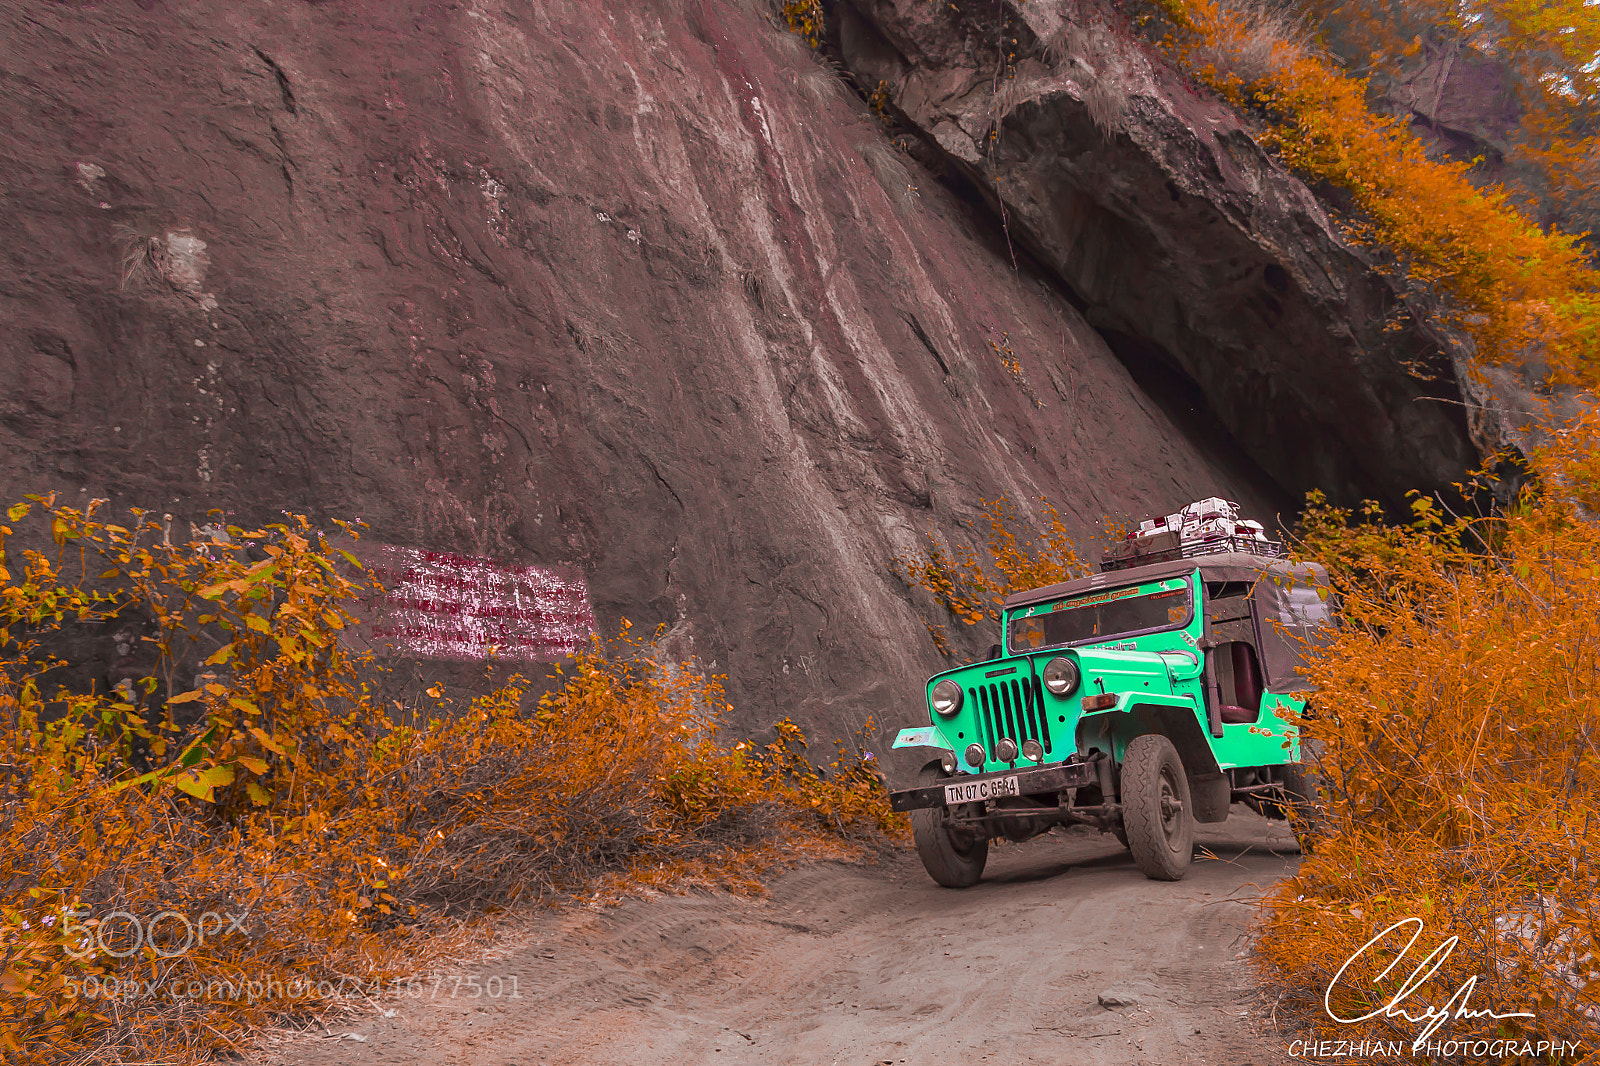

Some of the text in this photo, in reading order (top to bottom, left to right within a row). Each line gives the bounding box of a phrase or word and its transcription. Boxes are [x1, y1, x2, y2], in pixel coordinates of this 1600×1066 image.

[948, 786, 964, 802] TN
[966, 784, 977, 800] 07
[980, 782, 988, 798] C
